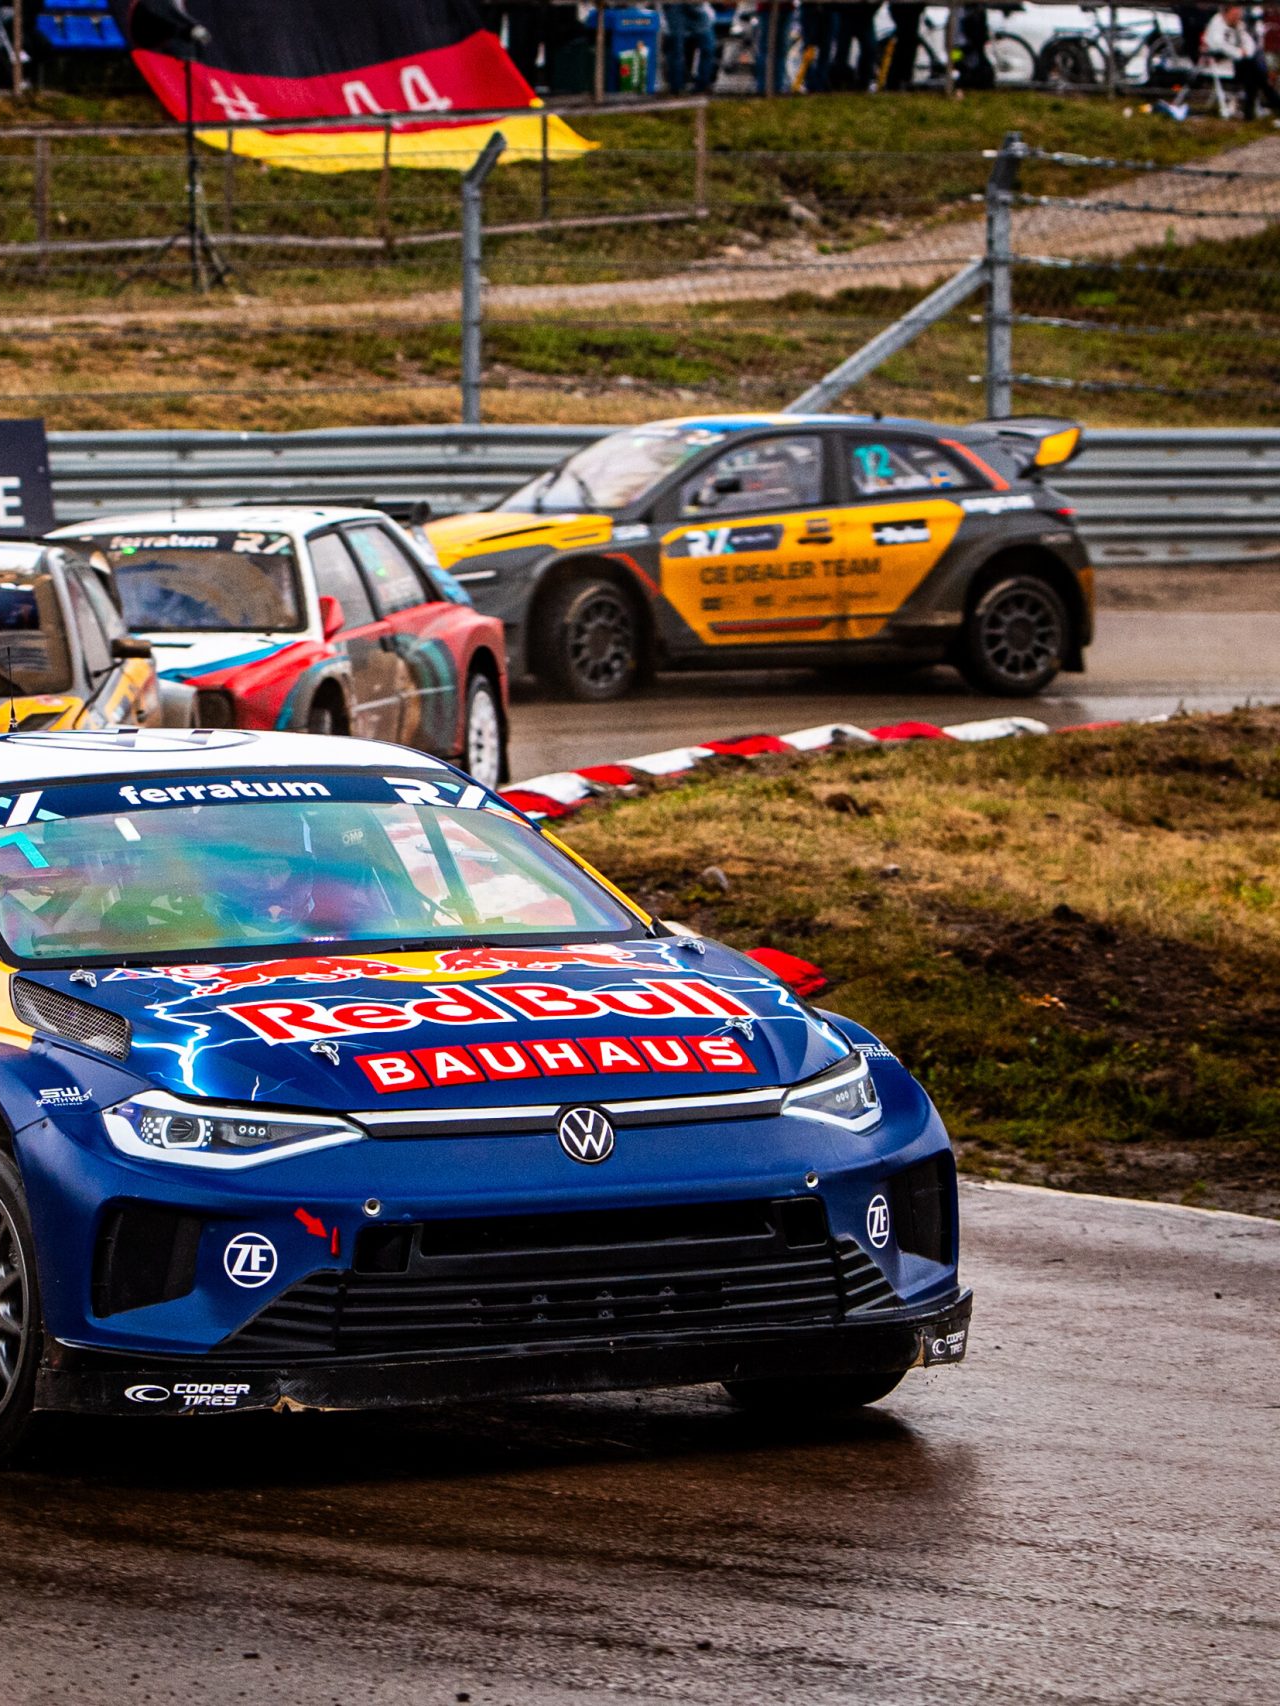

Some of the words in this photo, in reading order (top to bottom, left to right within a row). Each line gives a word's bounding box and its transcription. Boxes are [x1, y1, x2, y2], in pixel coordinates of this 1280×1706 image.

[110, 534, 219, 549] ferratum
[732, 561, 814, 584] DEALER
[820, 557, 882, 578] TEAM
[120, 777, 332, 805] ferratum
[382, 777, 506, 811] RX
[222, 984, 517, 1045] Red
[518, 976, 756, 1021] Bull
[367, 1038, 748, 1087] BAUHAUS
[868, 1202, 889, 1238] ZF
[228, 1241, 274, 1278] ZF
[173, 1383, 251, 1396] COOPER
[183, 1395, 239, 1408] TIRES
